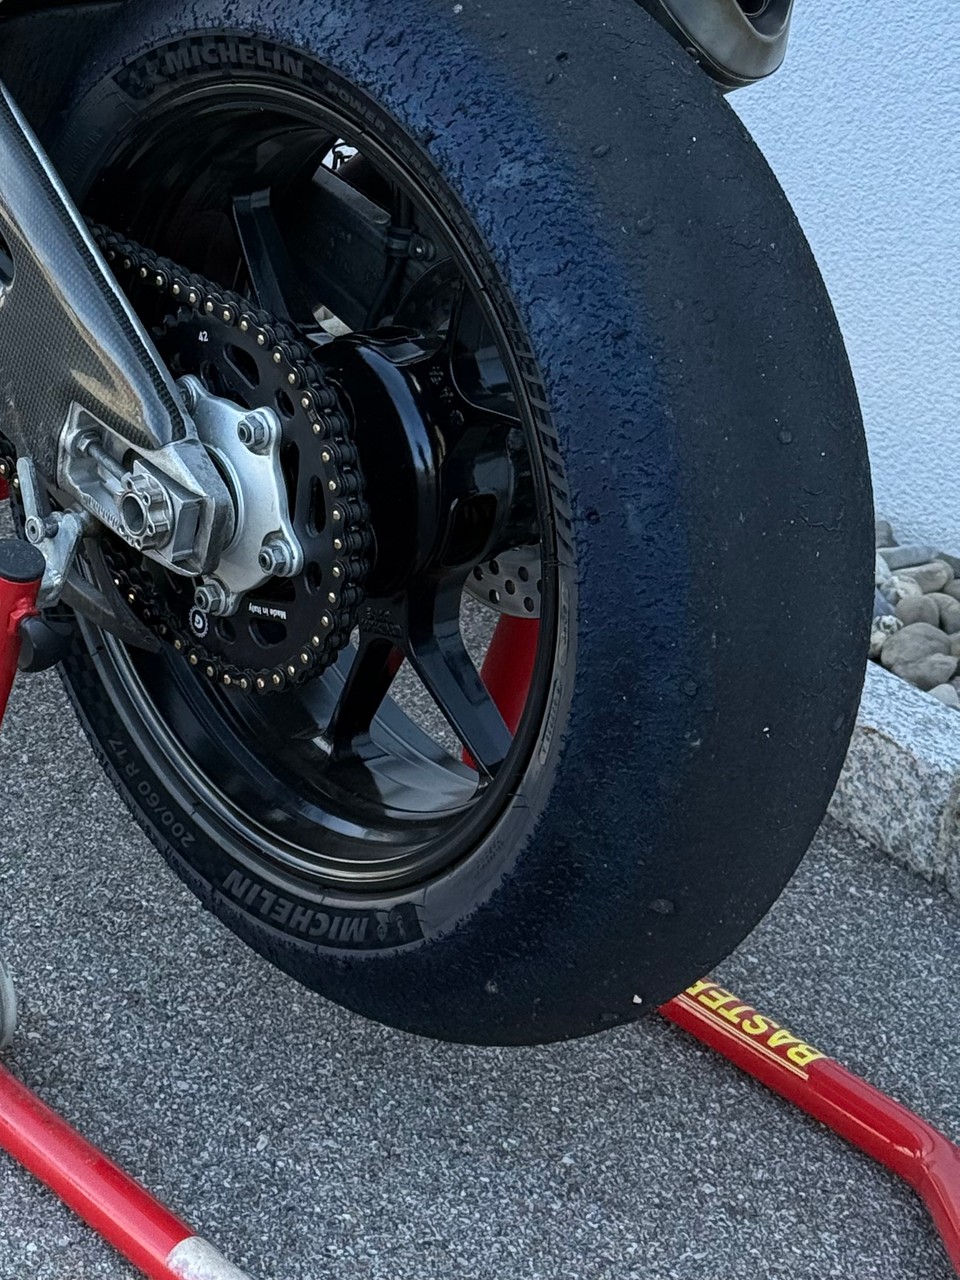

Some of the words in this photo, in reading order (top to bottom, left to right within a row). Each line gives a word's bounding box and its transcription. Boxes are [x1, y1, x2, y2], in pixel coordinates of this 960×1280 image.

[164, 42, 304, 80] MICHELIN
[326, 80, 387, 133] POWER
[198, 330, 209, 342] 42
[248, 602, 262, 615] Italy
[269, 608, 287, 620] Made
[107, 738, 128, 761] 17
[125, 760, 140, 778] R
[137, 780, 196, 848] 200/60
[222, 868, 369, 942] MICHELIN
